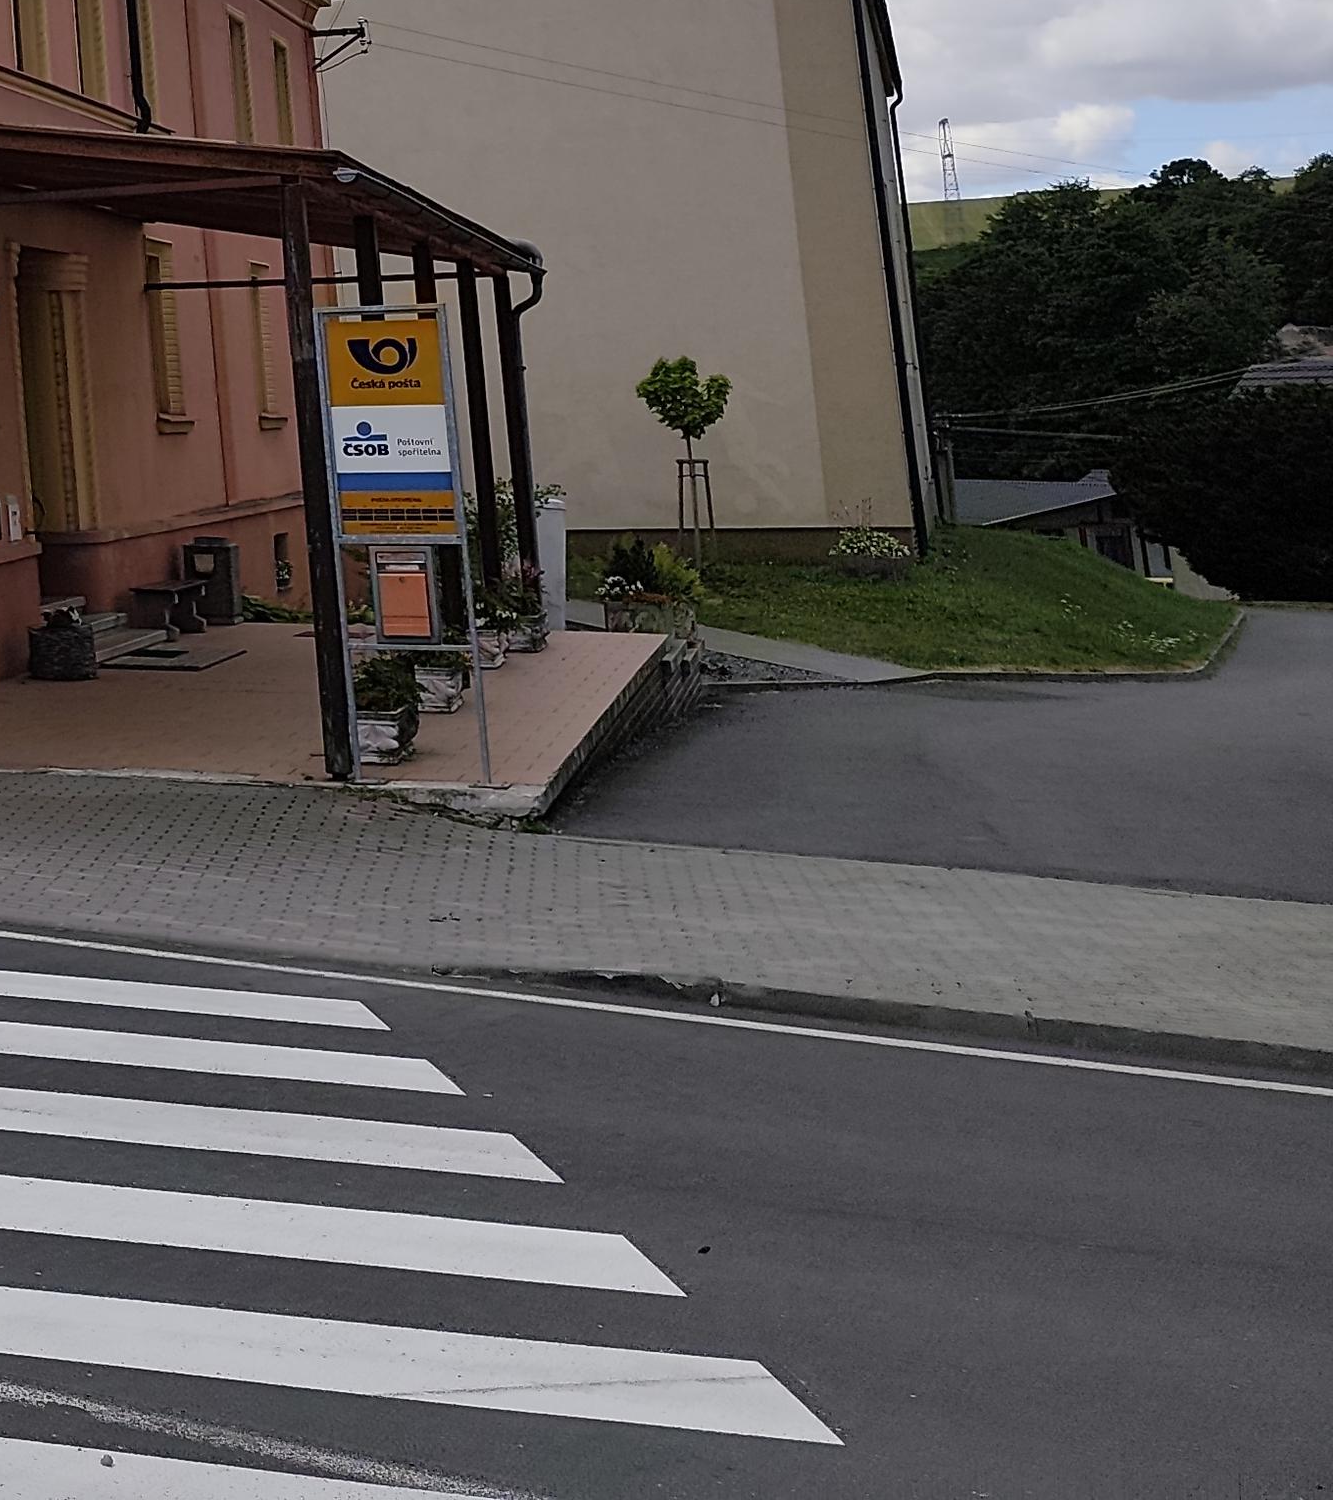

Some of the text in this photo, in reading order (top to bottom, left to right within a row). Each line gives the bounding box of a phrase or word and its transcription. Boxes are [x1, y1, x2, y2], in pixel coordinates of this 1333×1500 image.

[351, 377, 422, 390] Česká pošta
[397, 438, 433, 446] Poštovní
[342, 443, 390, 457] ČSOB
[397, 447, 442, 457] spořitelna
